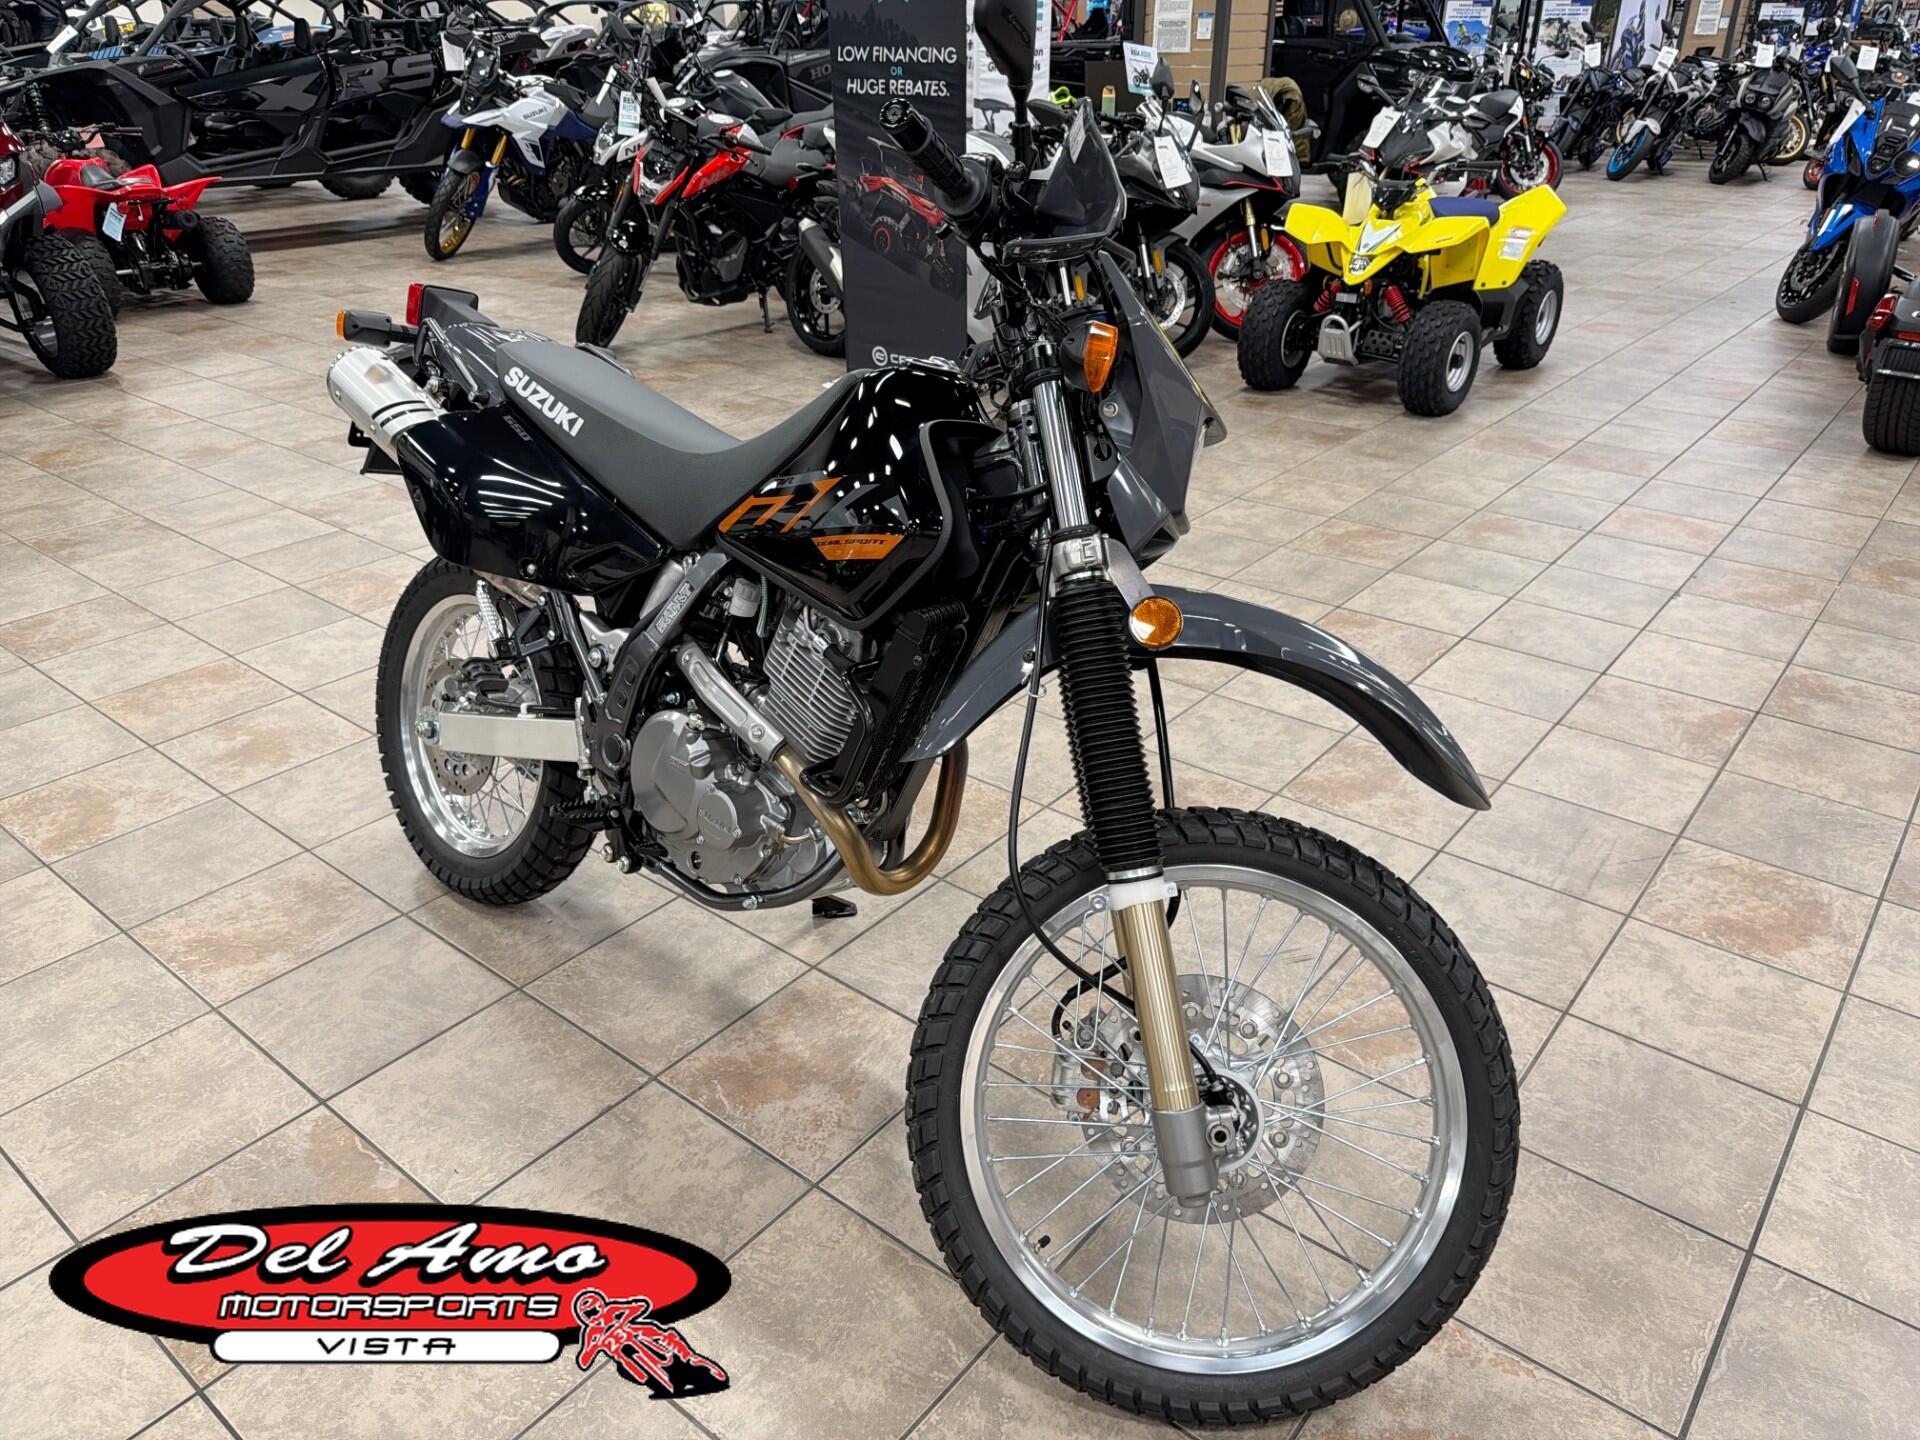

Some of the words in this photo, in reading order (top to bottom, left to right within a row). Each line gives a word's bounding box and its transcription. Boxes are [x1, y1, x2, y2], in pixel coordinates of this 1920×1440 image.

[837, 45, 870, 62] LOW
[872, 46, 958, 64] FINANCING
[889, 65, 903, 77] OR
[846, 78, 886, 95] HUGE
[889, 79, 950, 97] REBATES.
[522, 105, 549, 121] SUZUKI
[504, 366, 584, 437] SUZUKI
